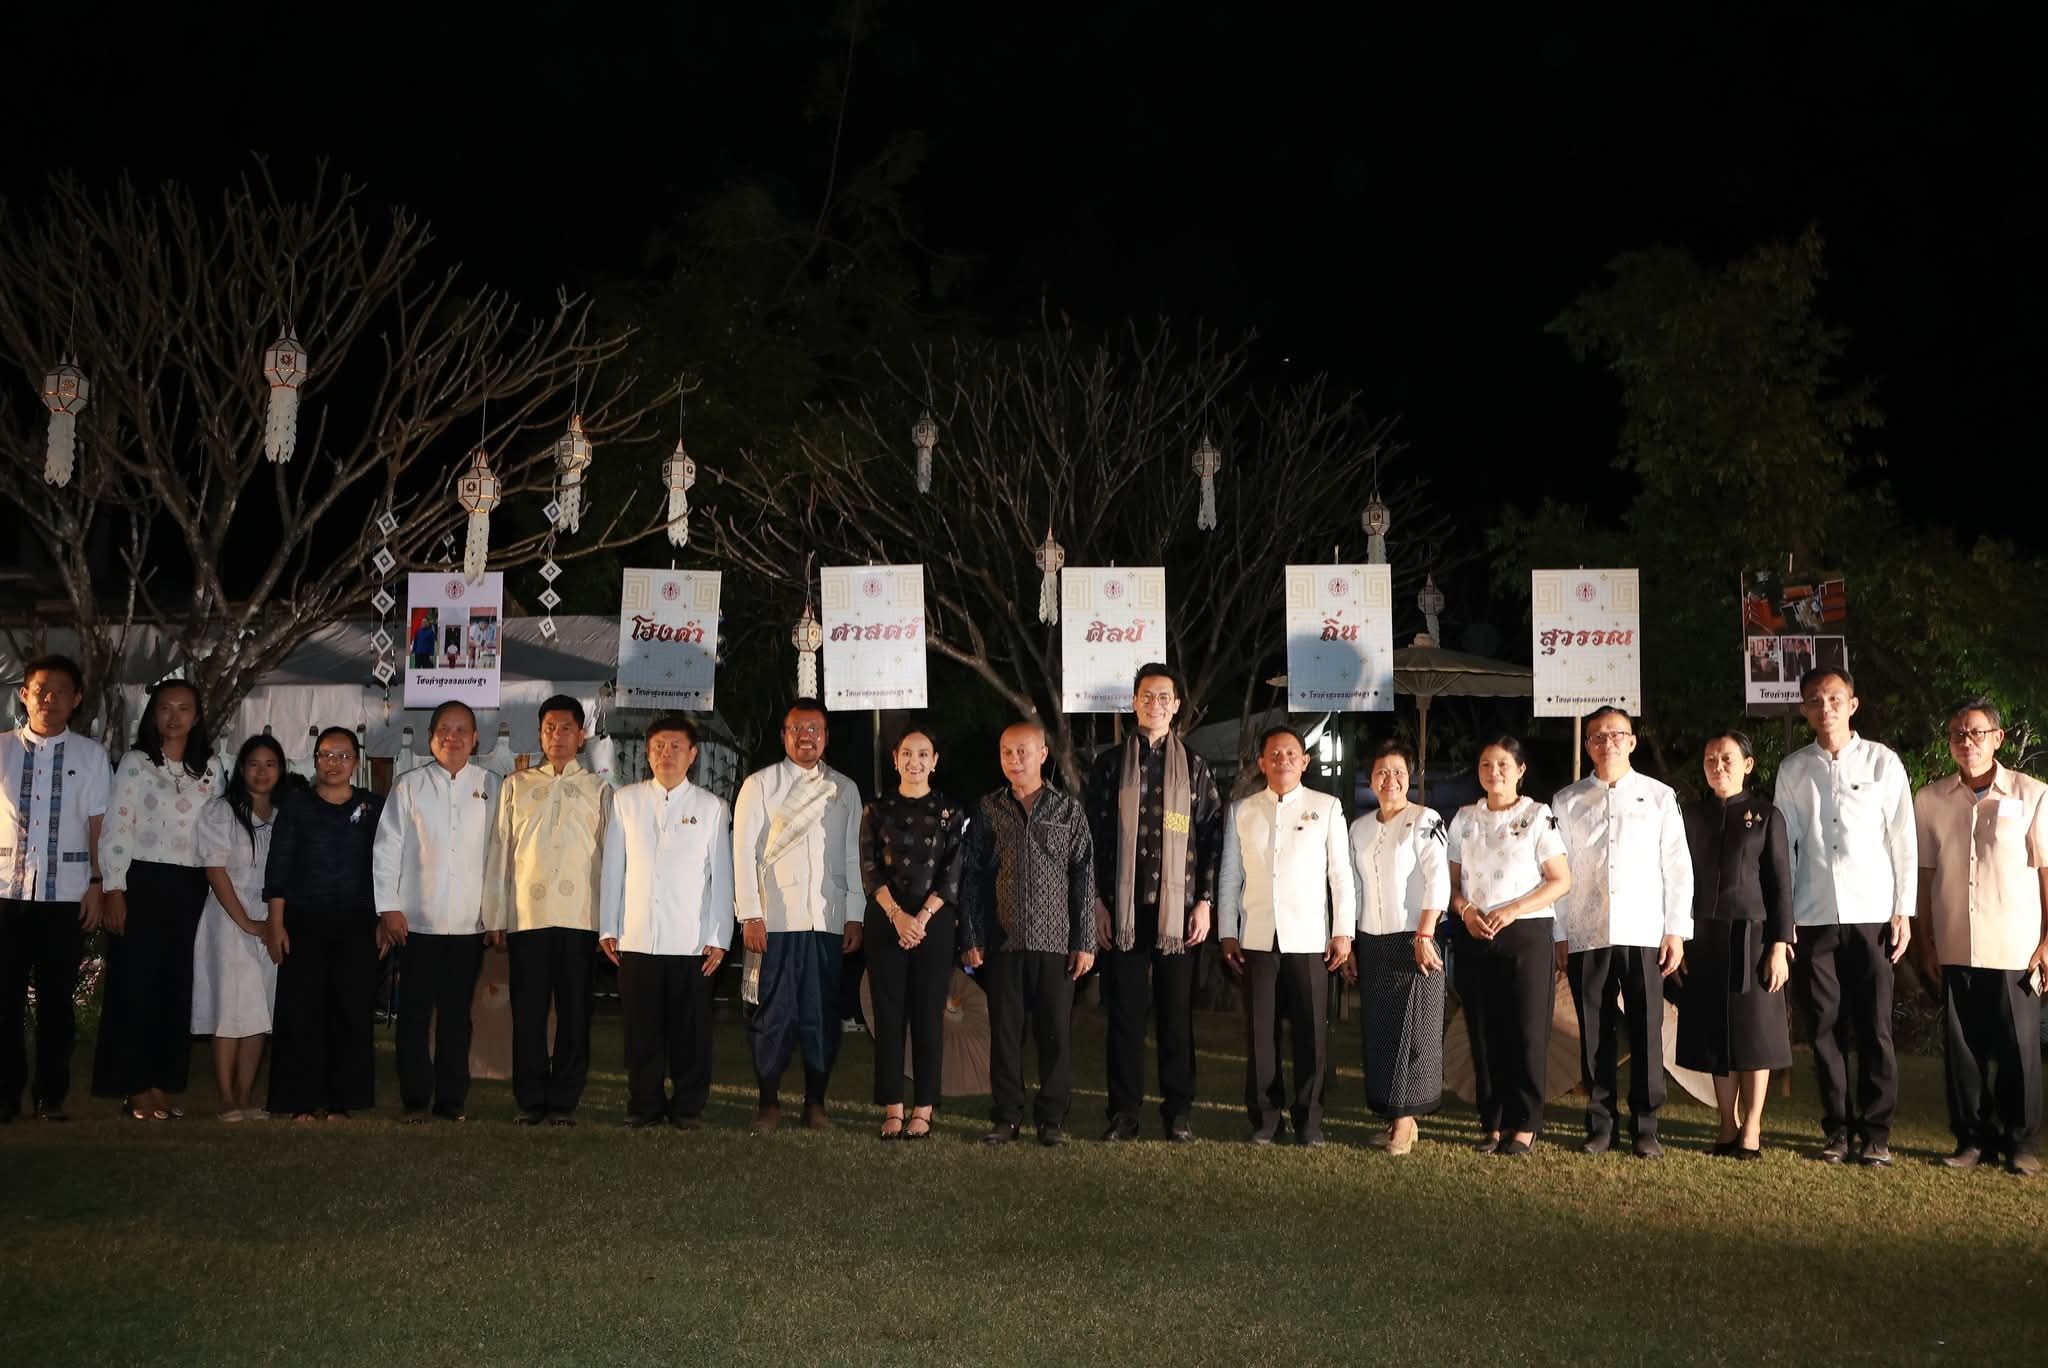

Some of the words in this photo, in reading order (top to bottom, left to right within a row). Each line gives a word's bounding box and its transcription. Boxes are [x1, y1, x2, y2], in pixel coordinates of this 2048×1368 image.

[631, 615, 705, 643] โฮงคำ
[830, 616, 924, 642] ศาสตร์
[1085, 619, 1146, 643] ศิลป์
[1320, 609, 1360, 641] ถิ่น
[1540, 628, 1634, 655] สุวรรณ
